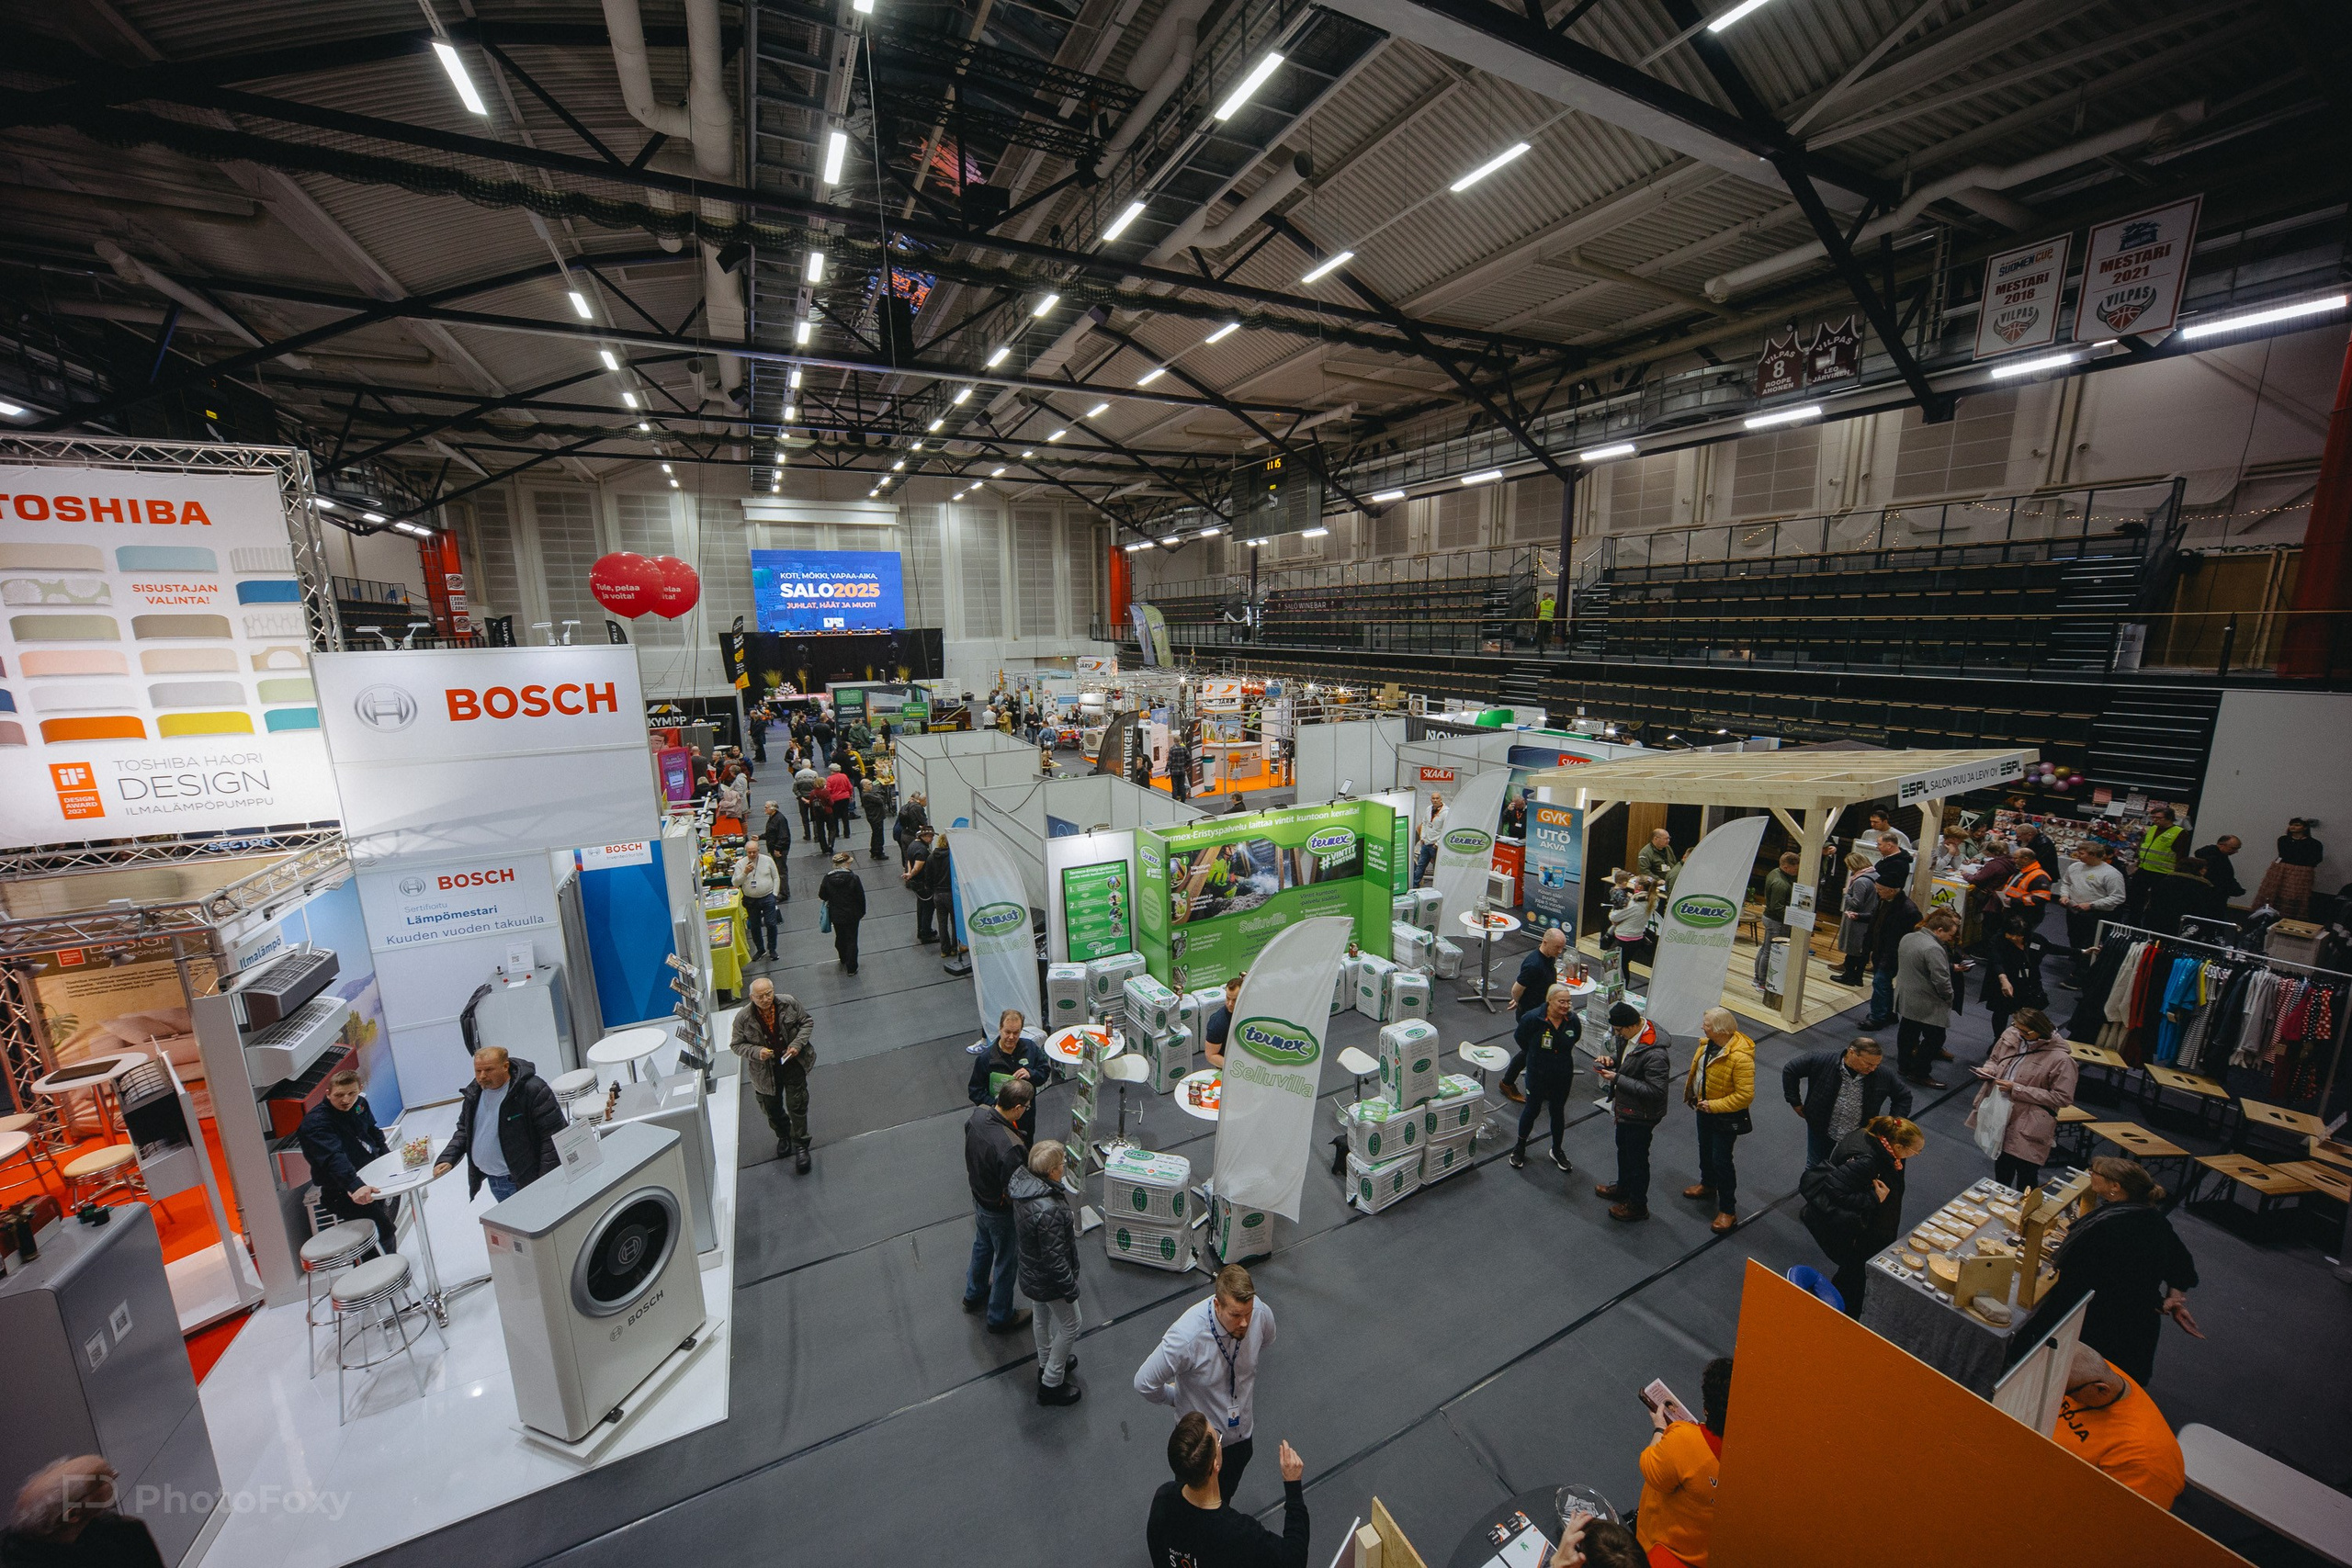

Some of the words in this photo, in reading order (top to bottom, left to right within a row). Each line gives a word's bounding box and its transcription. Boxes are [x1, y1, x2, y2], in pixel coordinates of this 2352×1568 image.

[2099, 243, 2172, 274] MESTARI
[2113, 265, 2150, 285] 2021
[1996, 272, 2050, 296] MESTARI
[2004, 288, 2035, 305] 2018
[2105, 286, 2150, 307] VILPAS
[2000, 307, 2033, 323] VILPAS
[1815, 336, 1853, 351] VILPAS
[1765, 350, 1796, 365] VILPAS
[1829, 345, 1838, 366] 1
[1773, 360, 1785, 378] 8
[1762, 382, 1794, 395] AHONEN
[1765, 377, 1792, 389] ROOPE
[802, 571, 830, 580] MÖKKI,
[132, 583, 219, 594] SISUSTAJAN
[596, 583, 614, 592] Tule,
[615, 584, 640, 592] pelaa
[780, 582, 880, 598] SALO2025
[146, 595, 210, 605] VALINTA!
[445, 682, 618, 722] BOSCH
[113, 756, 198, 772] TOSHIBA
[205, 753, 264, 767] HAORI
[1422, 769, 1452, 778] SKAALA
[1930, 777, 1951, 790] SALON
[1953, 773, 1966, 784] PUU
[1967, 773, 1974, 782] JA
[1975, 769, 1989, 781] LEVY
[1990, 767, 1998, 776] OY
[118, 770, 270, 801] DESIGN
[63, 795, 96, 804] DESIGN
[65, 801, 98, 809] AWARD
[125, 797, 275, 816] ILMALÄMPÖPUMPPU
[67, 807, 87, 816] 2021
[1250, 818, 1272, 829] laittaa
[1274, 816, 1295, 825] vintit
[1296, 812, 1329, 822] kuntoon
[1331, 807, 1360, 818] kerralla!
[1541, 810, 1567, 826] GVK
[209, 837, 273, 851] SECTOR
[1311, 834, 1350, 848] termex
[1450, 835, 1485, 846] termex
[1536, 828, 1571, 844] UTÖ
[605, 842, 642, 853] BOSCH
[1540, 840, 1566, 852] AKVA
[437, 868, 514, 891] BOSCH
[404, 901, 447, 914] Sertifioitu
[406, 904, 498, 926] Lämpömestari
[1681, 903, 1728, 919] termex
[386, 930, 438, 945] Kuuden
[442, 922, 491, 937] vuoden
[494, 913, 545, 930] takuulla
[1238, 912, 1286, 933] Selluvilla
[1665, 929, 1730, 947] Selluvilla
[240, 935, 282, 971] Ilmalämpö
[1245, 1026, 1309, 1055] termex
[1230, 1059, 1315, 1098] Selluvilla
[628, 1290, 664, 1327] BOSCH
